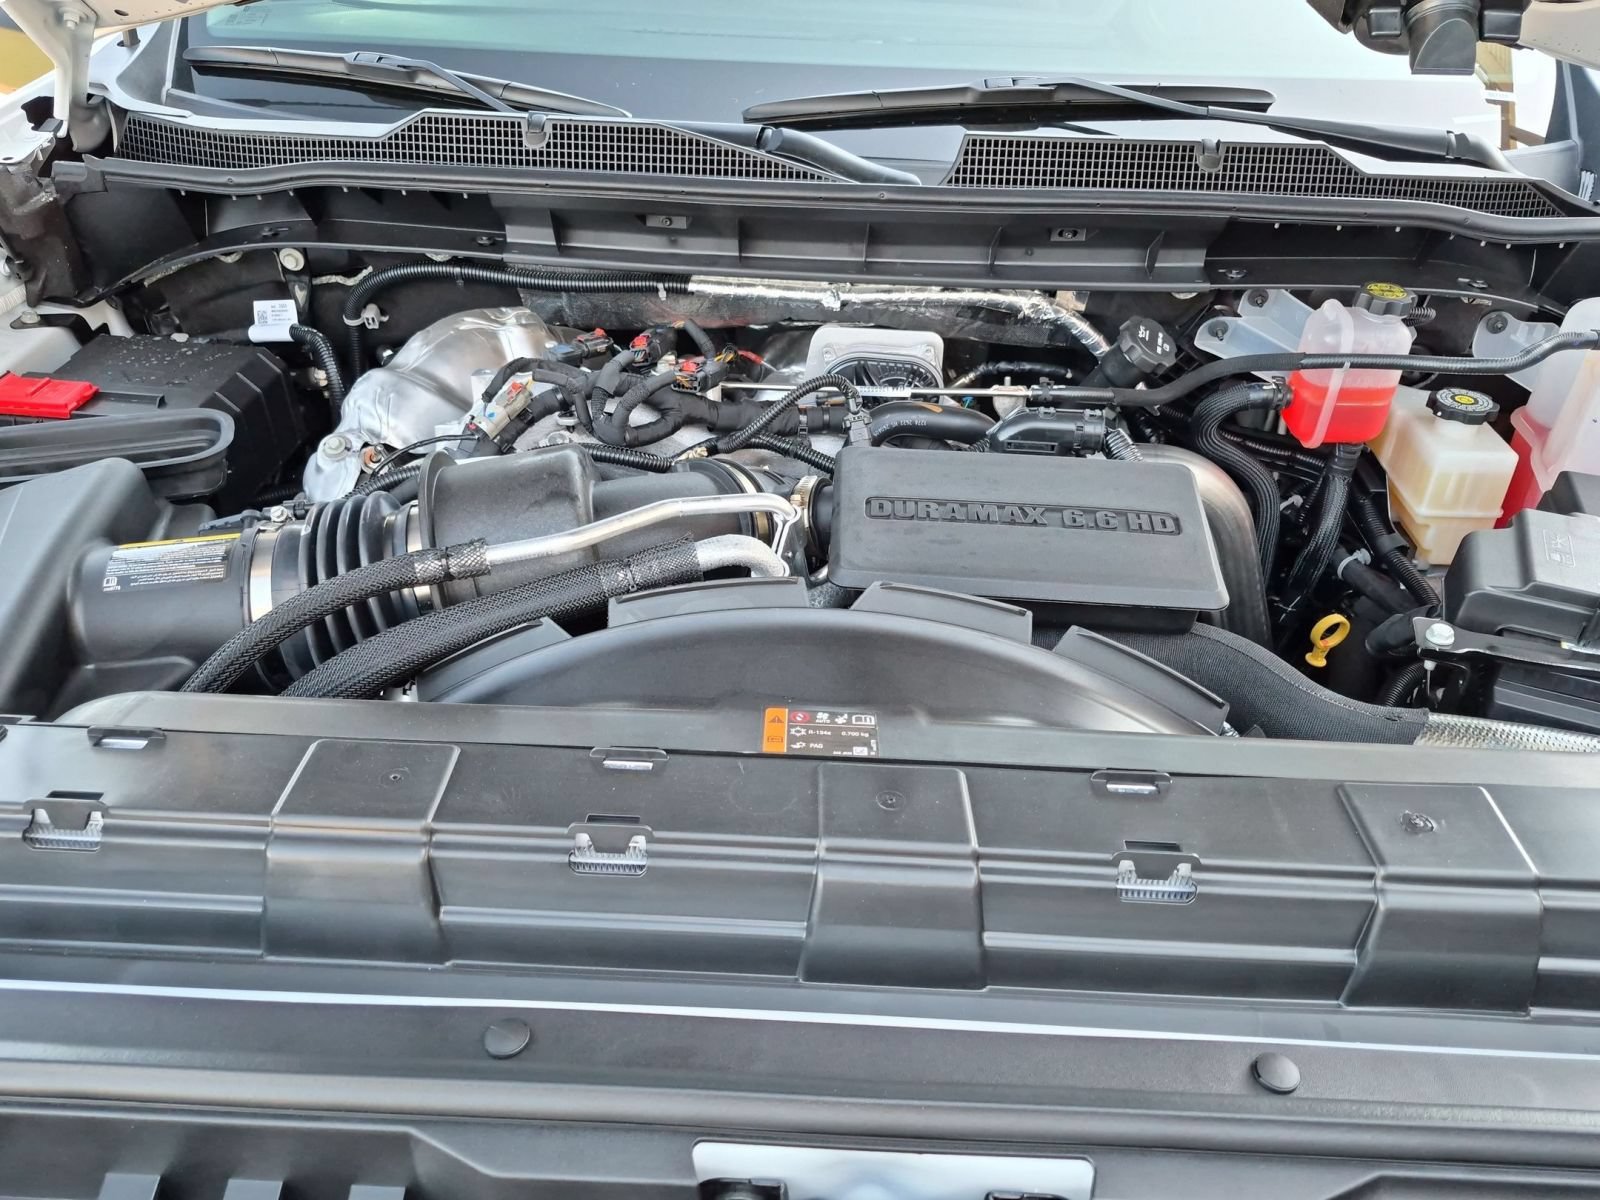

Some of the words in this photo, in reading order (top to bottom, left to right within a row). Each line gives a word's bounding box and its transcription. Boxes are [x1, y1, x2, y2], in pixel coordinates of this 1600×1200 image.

[869, 499, 1048, 526] DURAMAX
[1062, 508, 1119, 531] 6.6
[1127, 511, 1179, 534] HD
